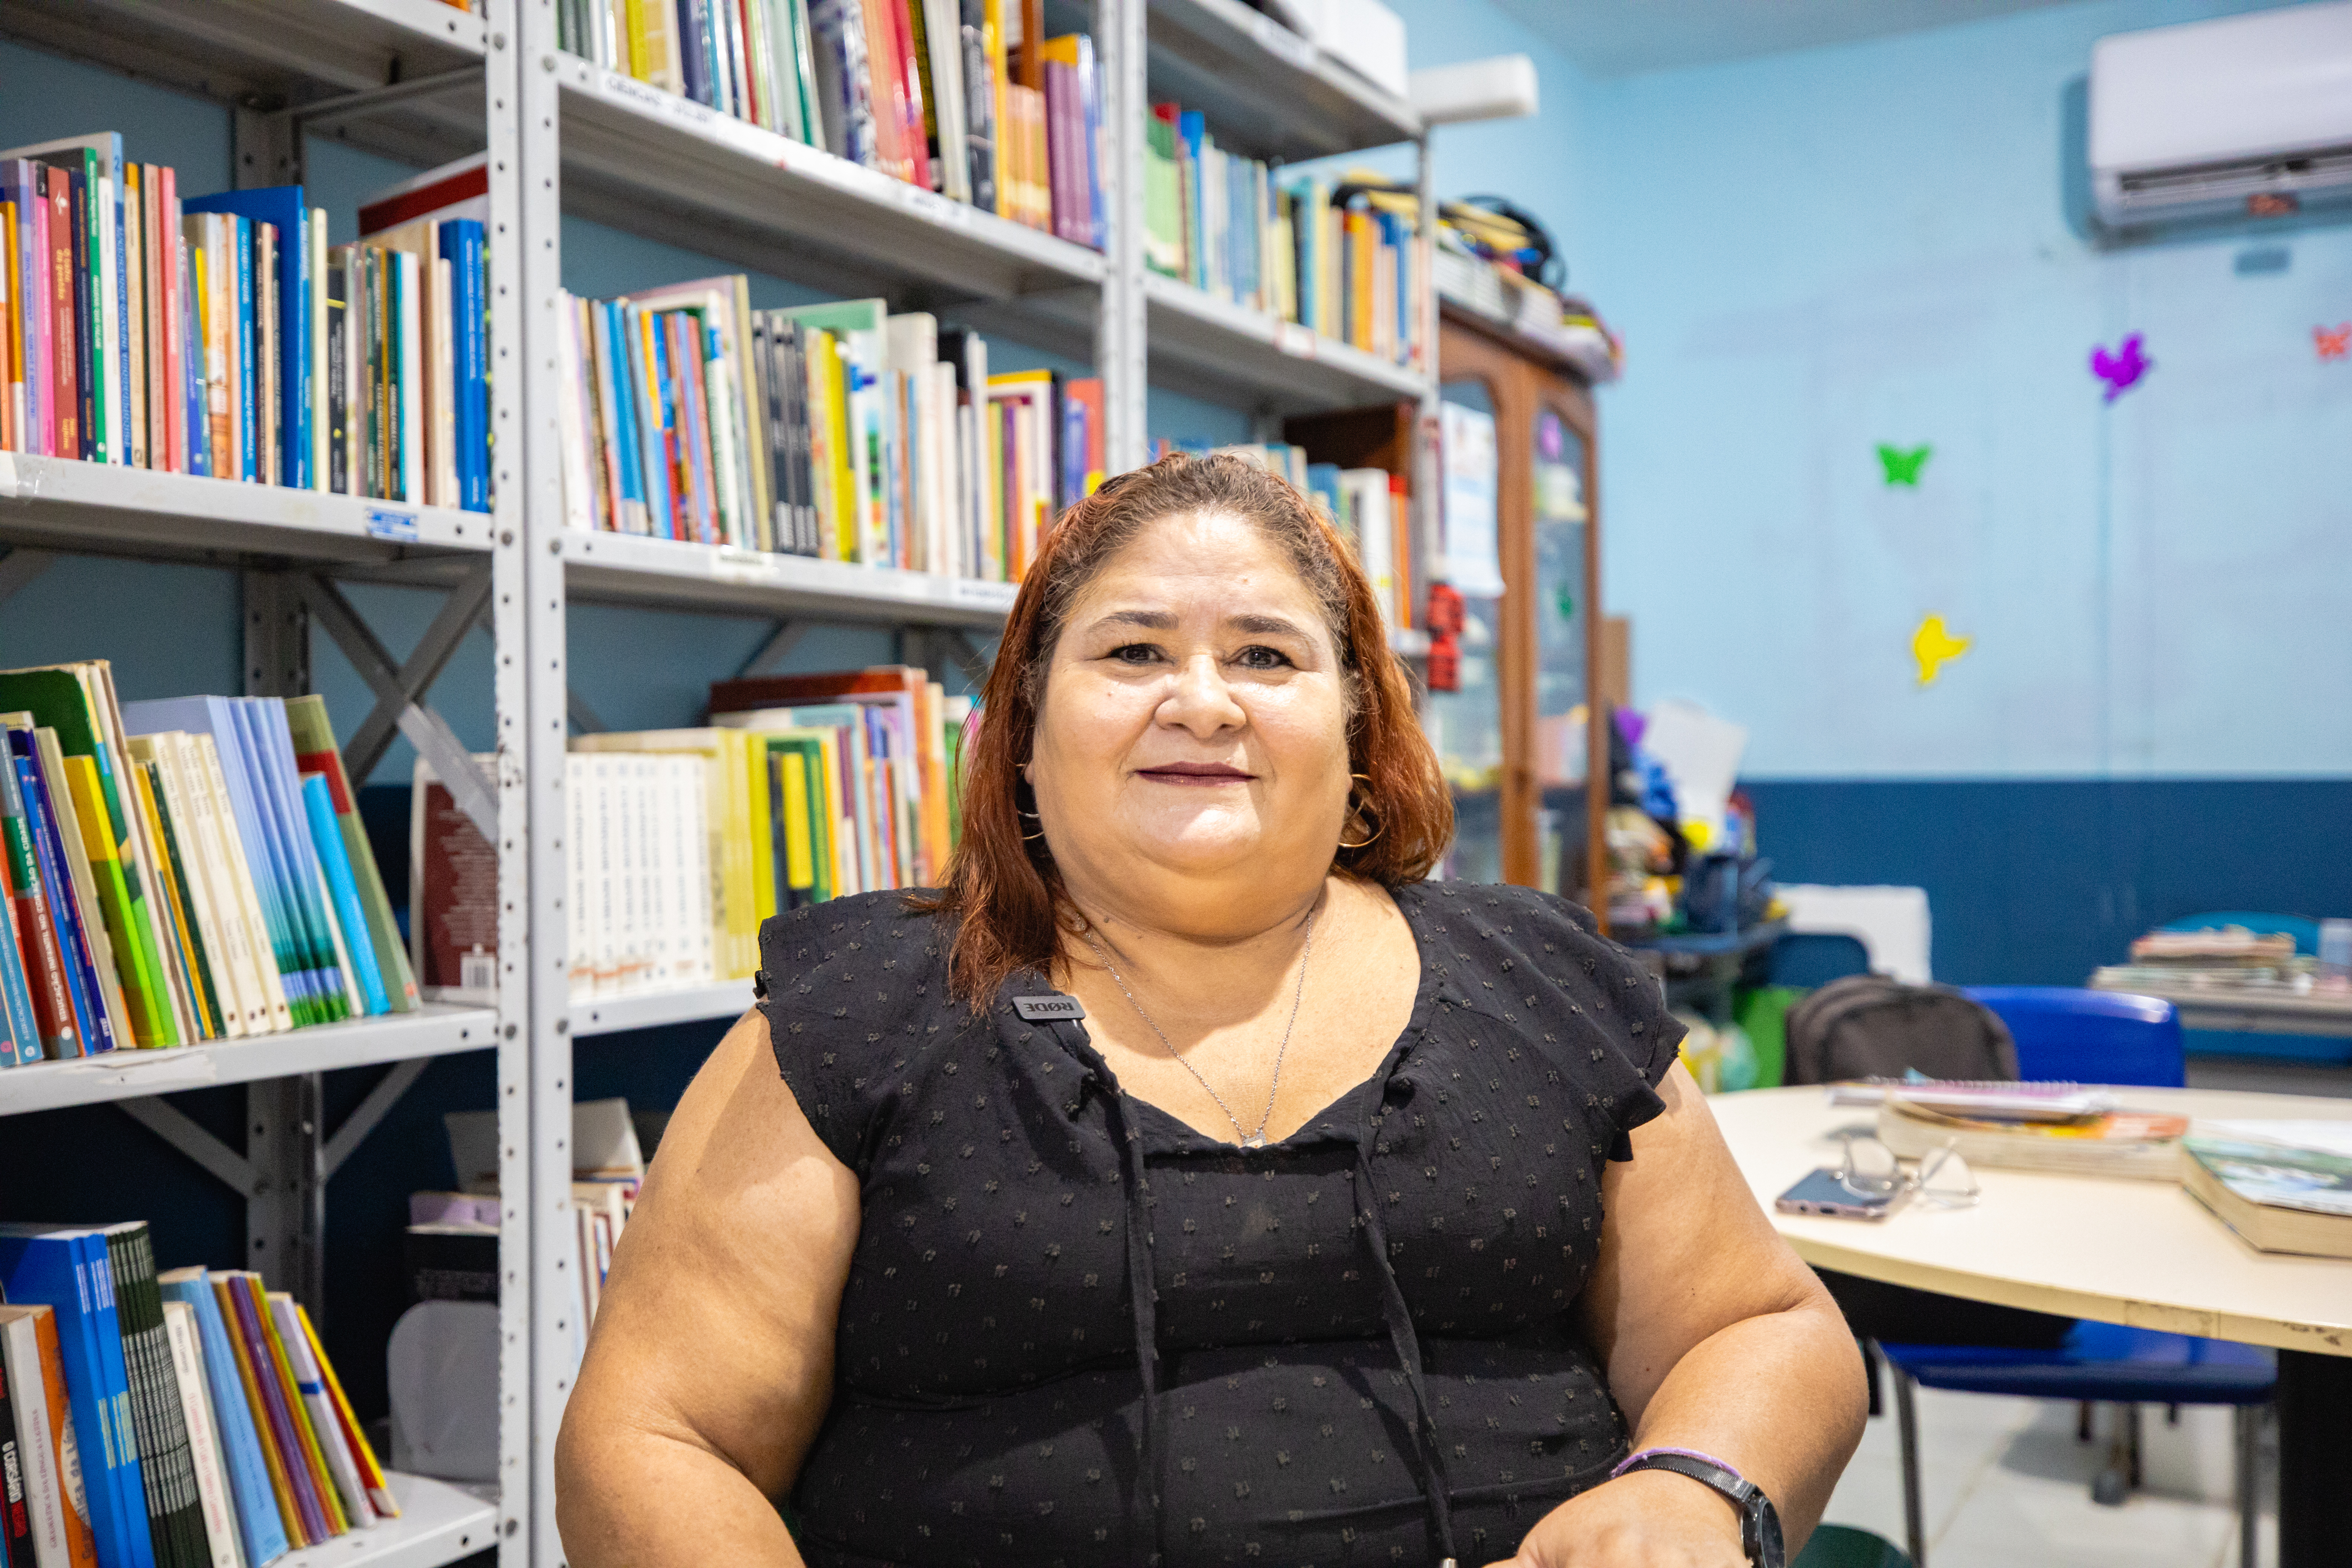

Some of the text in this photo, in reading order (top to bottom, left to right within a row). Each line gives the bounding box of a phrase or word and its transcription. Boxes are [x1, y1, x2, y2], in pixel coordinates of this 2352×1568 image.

[17, 817, 31, 851] CIDADE
[26, 850, 36, 866] DA
[29, 868, 44, 913] CORAÇÃO
[38, 913, 46, 930] NO
[41, 929, 58, 972] INFANTIL
[51, 972, 67, 1022] EDUCAÇÃO
[1023, 1002, 1075, 1012] RØDE
[2, 1440, 15, 1452] O
[3, 1450, 22, 1504] CORSÁRIO
